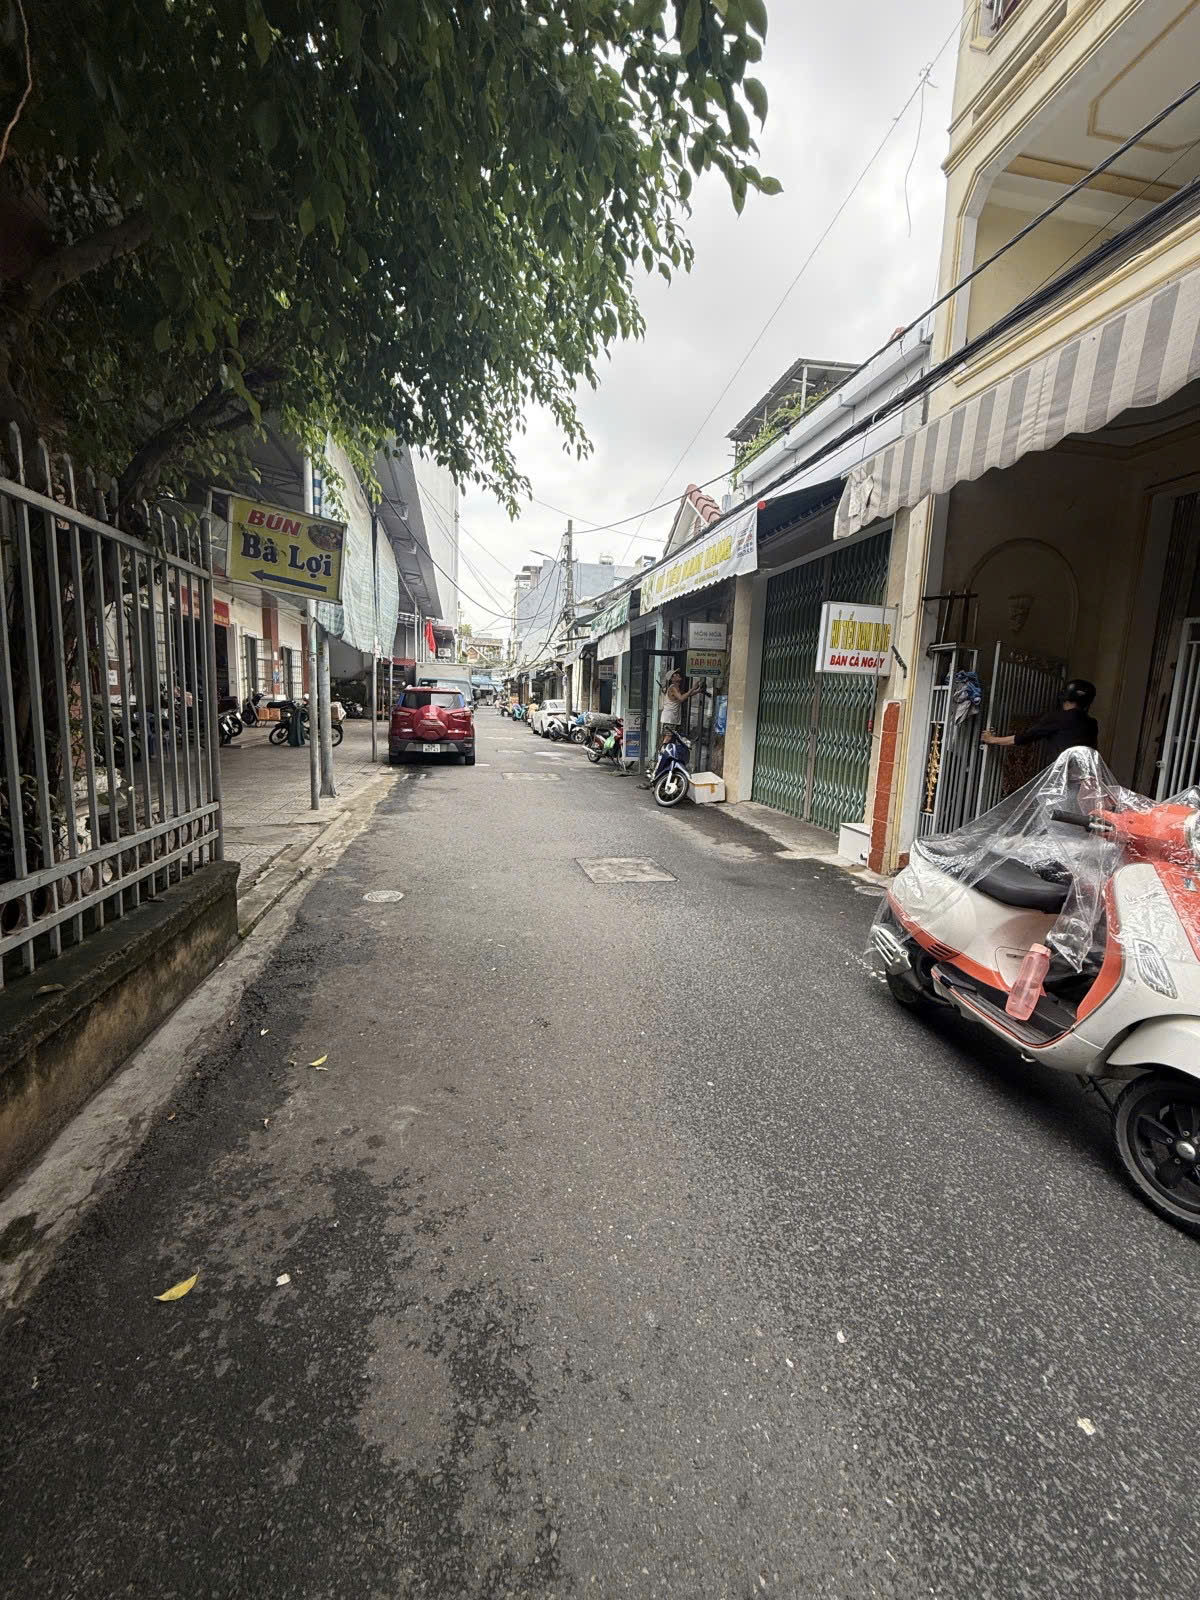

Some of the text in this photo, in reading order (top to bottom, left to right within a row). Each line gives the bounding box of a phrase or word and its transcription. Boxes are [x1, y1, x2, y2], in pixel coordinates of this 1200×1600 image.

[247, 508, 302, 537] BÚN
[240, 531, 332, 578] Bà Lợi
